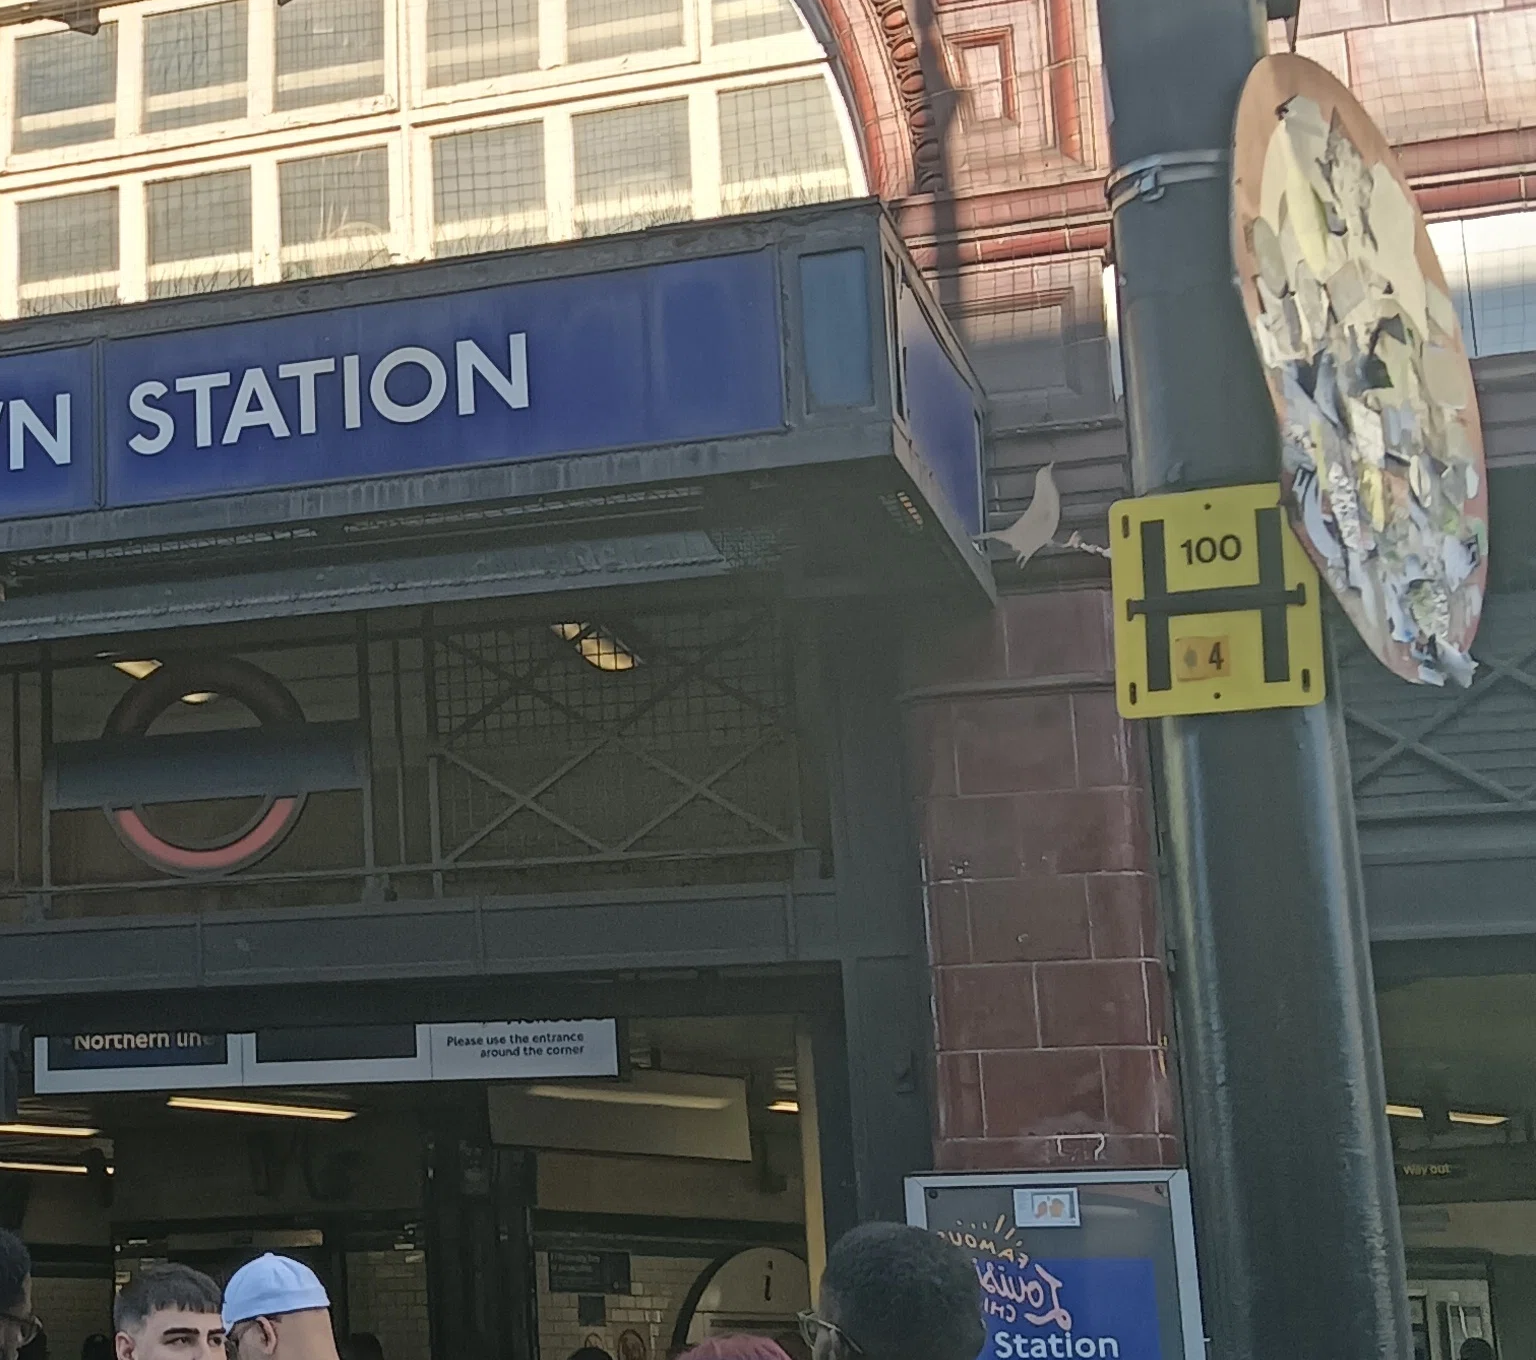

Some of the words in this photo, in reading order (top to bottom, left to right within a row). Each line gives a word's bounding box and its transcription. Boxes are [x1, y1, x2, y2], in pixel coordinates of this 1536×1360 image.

[126, 332, 531, 456] STATION
[1180, 534, 1242, 566] 100
[1208, 641, 1224, 670] 4
[74, 1031, 170, 1051] Northern
[446, 1035, 484, 1047] Please
[486, 1036, 506, 1045] use
[509, 1033, 530, 1044] the
[532, 1032, 584, 1043] entrance
[480, 1046, 520, 1058] around
[523, 1046, 543, 1056] the
[546, 1044, 585, 1056] corner
[1403, 1164, 1427, 1176] Way
[1429, 1162, 1451, 1175] out
[994, 1330, 1119, 1359] Station
